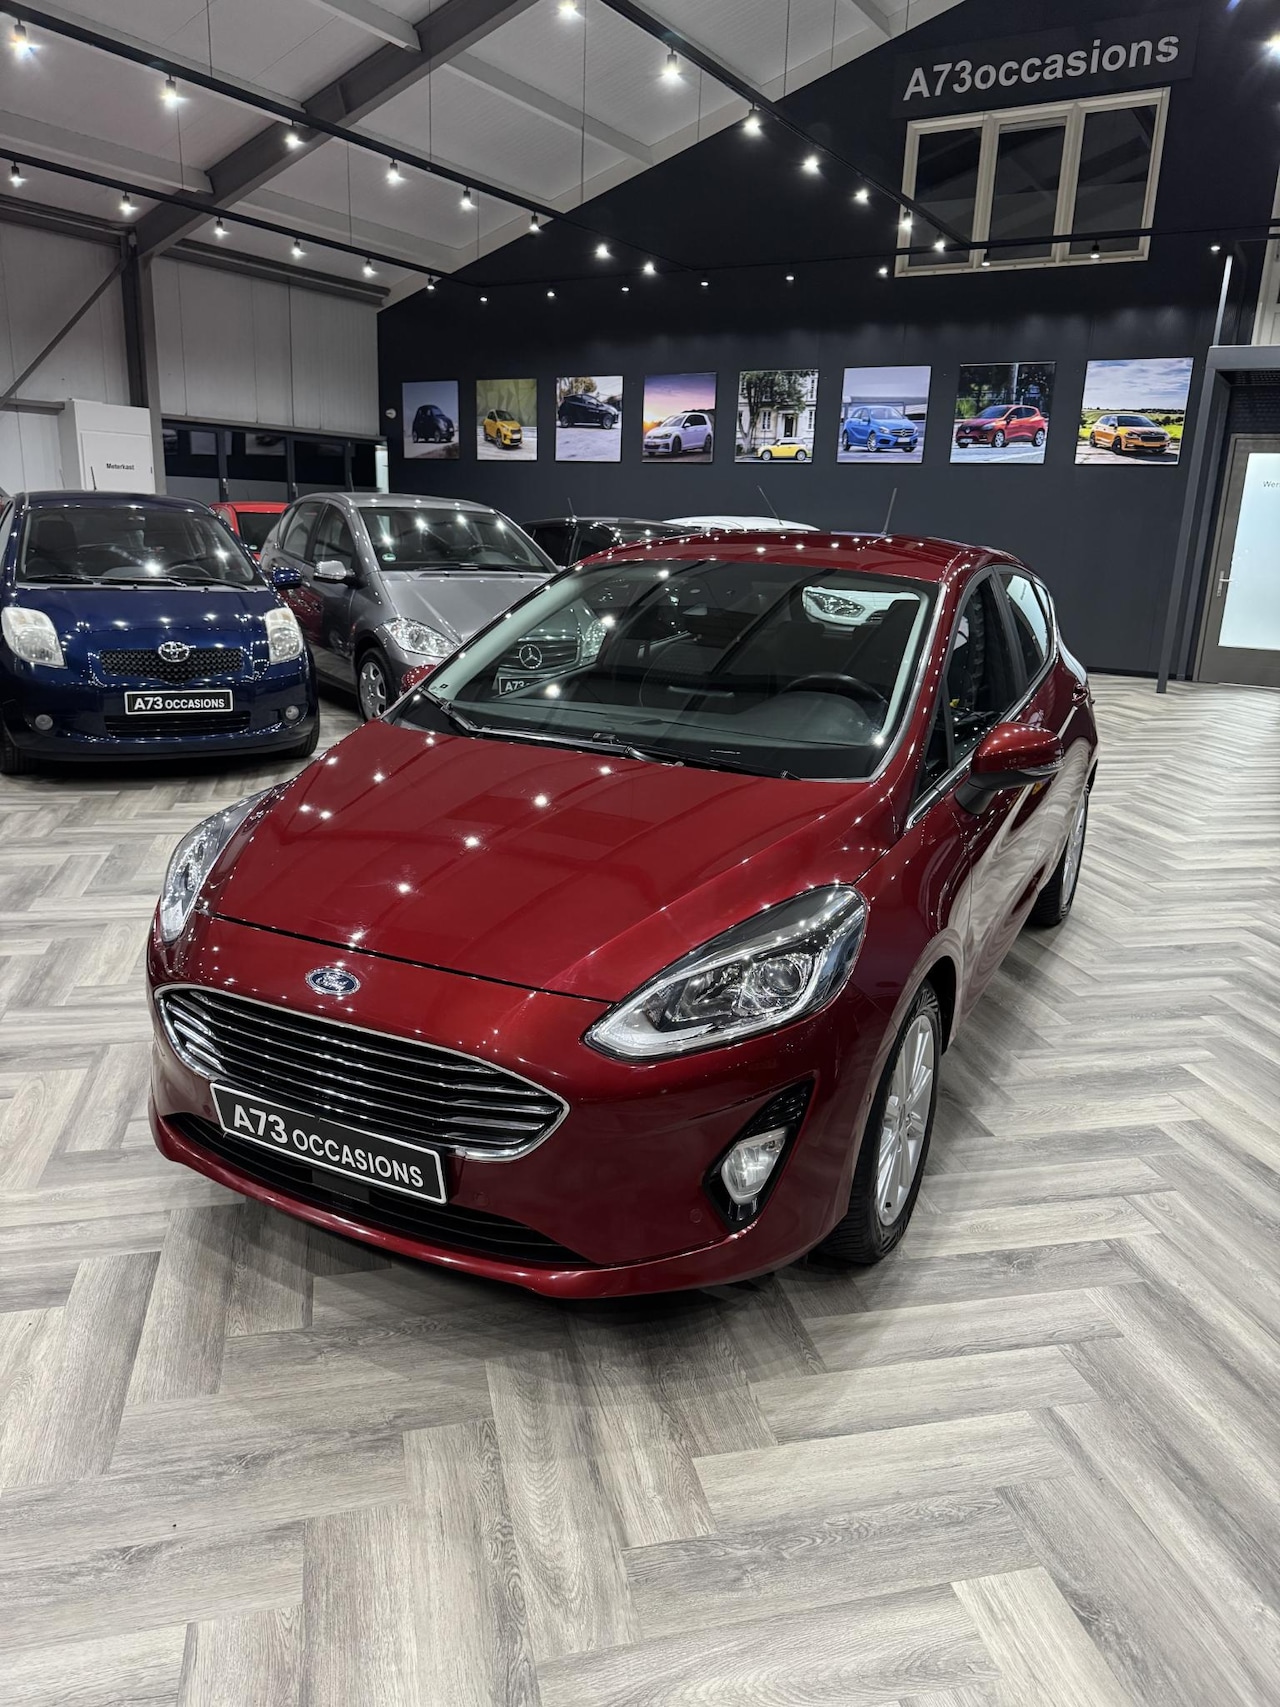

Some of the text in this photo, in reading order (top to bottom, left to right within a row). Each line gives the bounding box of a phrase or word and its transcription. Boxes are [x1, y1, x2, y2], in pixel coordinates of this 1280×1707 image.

[902, 35, 1180, 101] A73occasions
[1263, 480, 1280, 488] Wer
[134, 696, 225, 710] A73 OCCASIONS
[233, 1103, 424, 1187] A73 OCCASIONS
